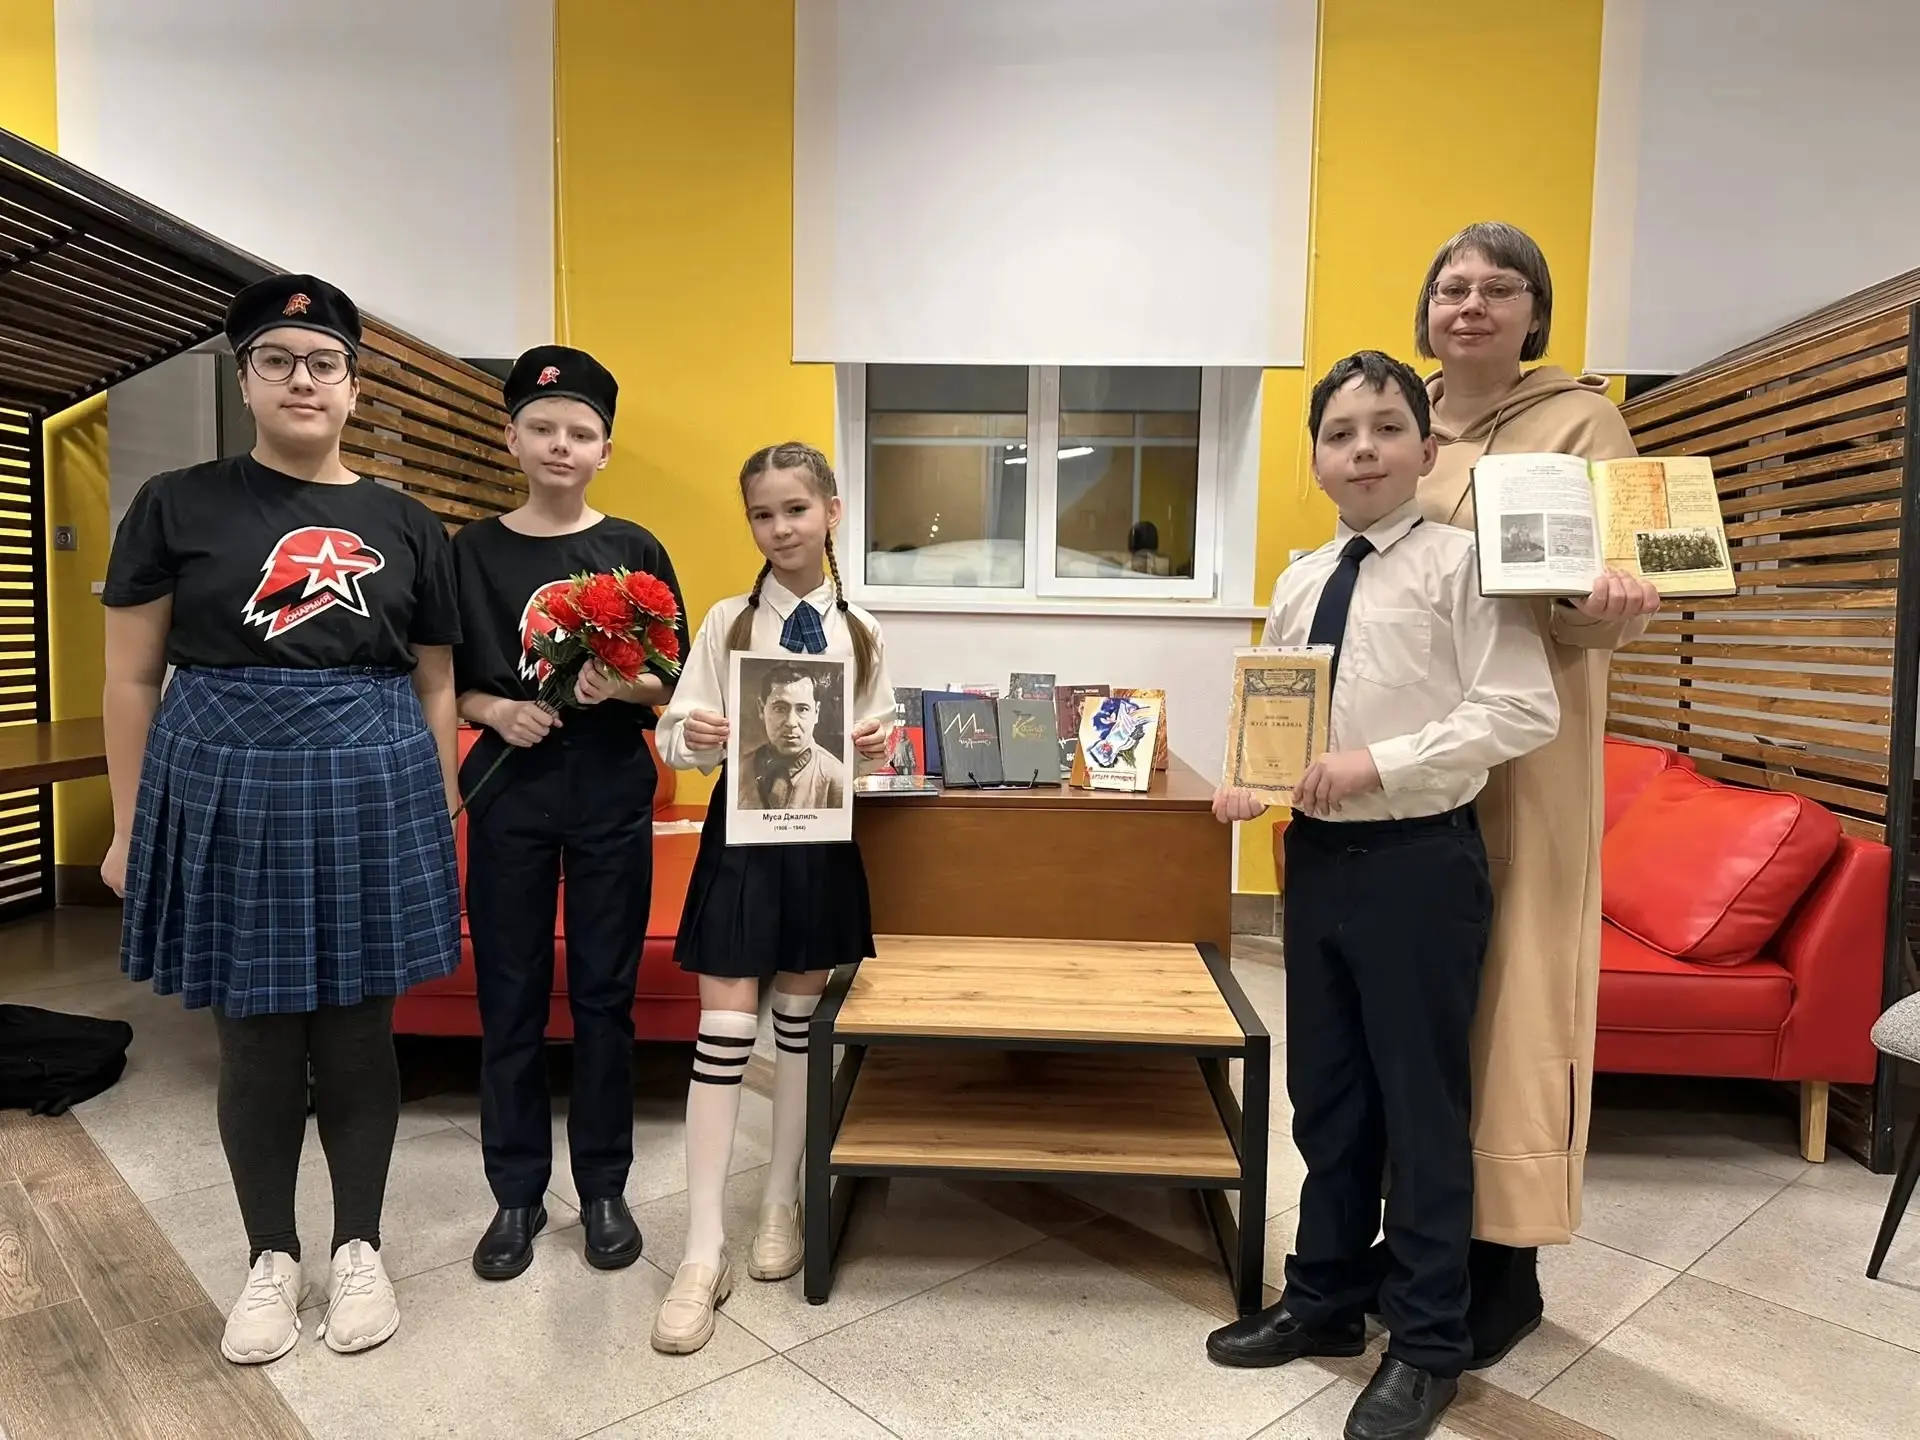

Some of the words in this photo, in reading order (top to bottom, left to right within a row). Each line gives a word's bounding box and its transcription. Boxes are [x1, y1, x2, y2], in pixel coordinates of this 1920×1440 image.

[284, 594, 332, 624] ЮНАРМИЯ
[762, 813, 782, 822] Муса
[783, 813, 818, 821] Джалиль
